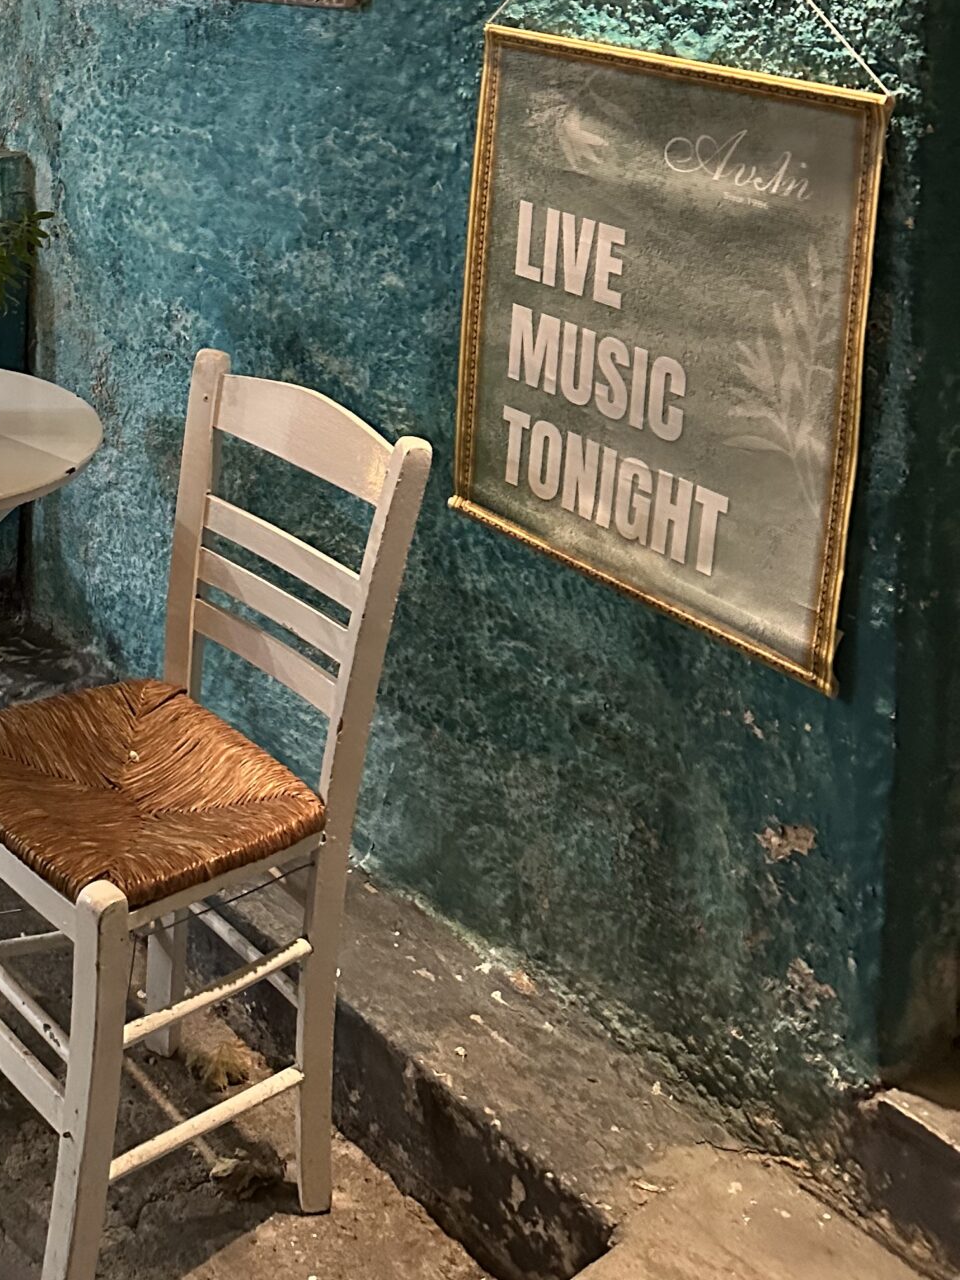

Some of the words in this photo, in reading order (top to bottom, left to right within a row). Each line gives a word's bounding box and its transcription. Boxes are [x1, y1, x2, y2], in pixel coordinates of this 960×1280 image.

[514, 200, 627, 309] LIVE
[507, 303, 686, 442] MUSIC
[502, 405, 729, 577] TONIGHT
